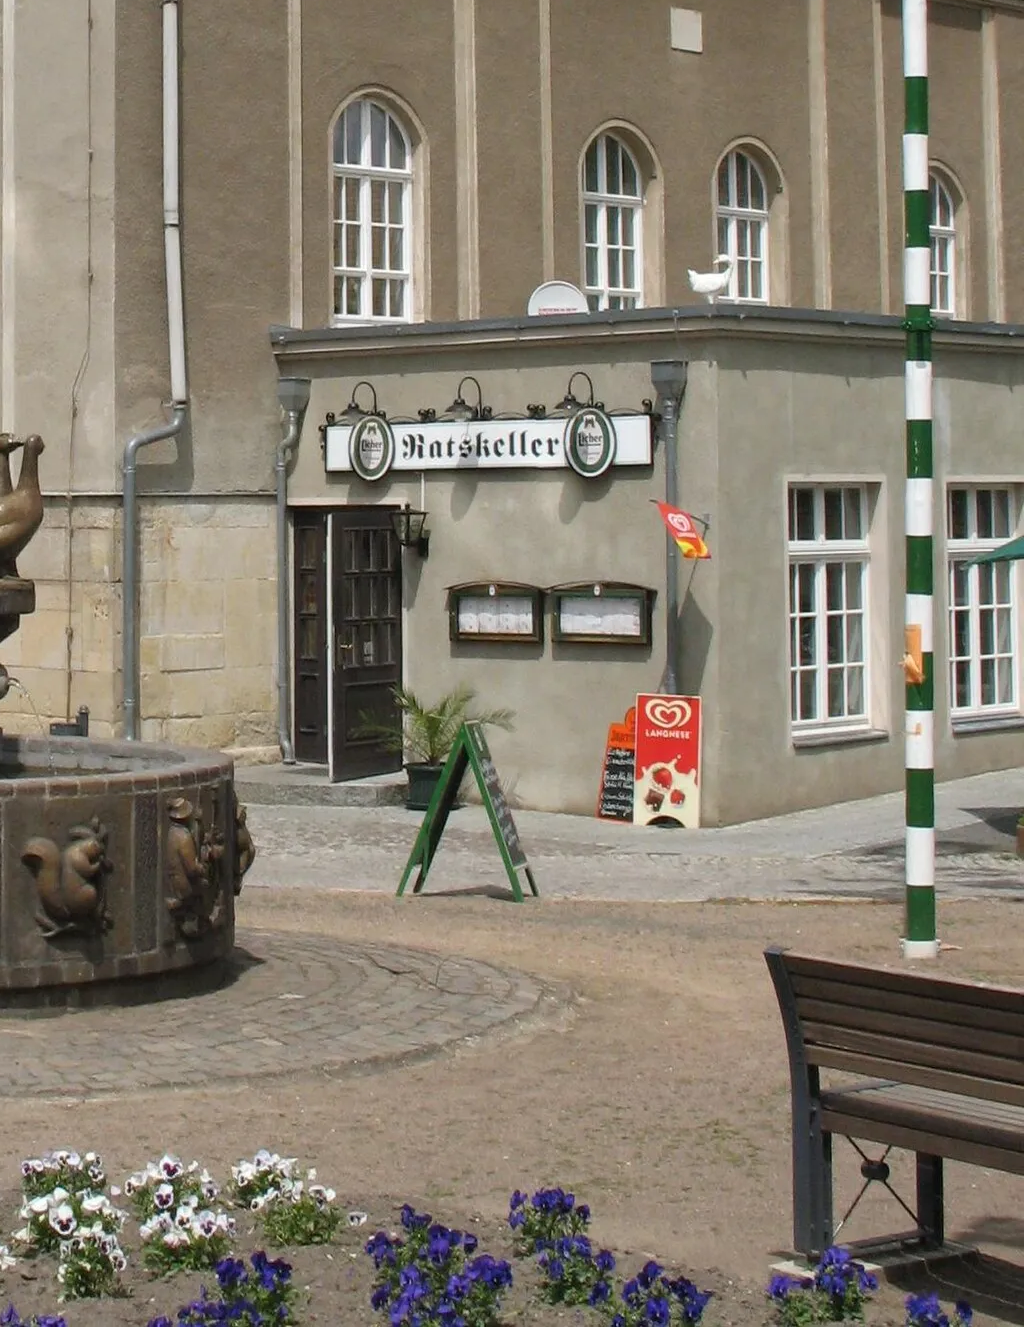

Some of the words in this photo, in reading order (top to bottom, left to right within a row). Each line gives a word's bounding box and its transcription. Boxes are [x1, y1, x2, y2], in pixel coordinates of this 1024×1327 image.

[401, 429, 560, 461] Ratskeller
[577, 432, 603, 447] Licher
[645, 728, 690, 740] LANGNESE
